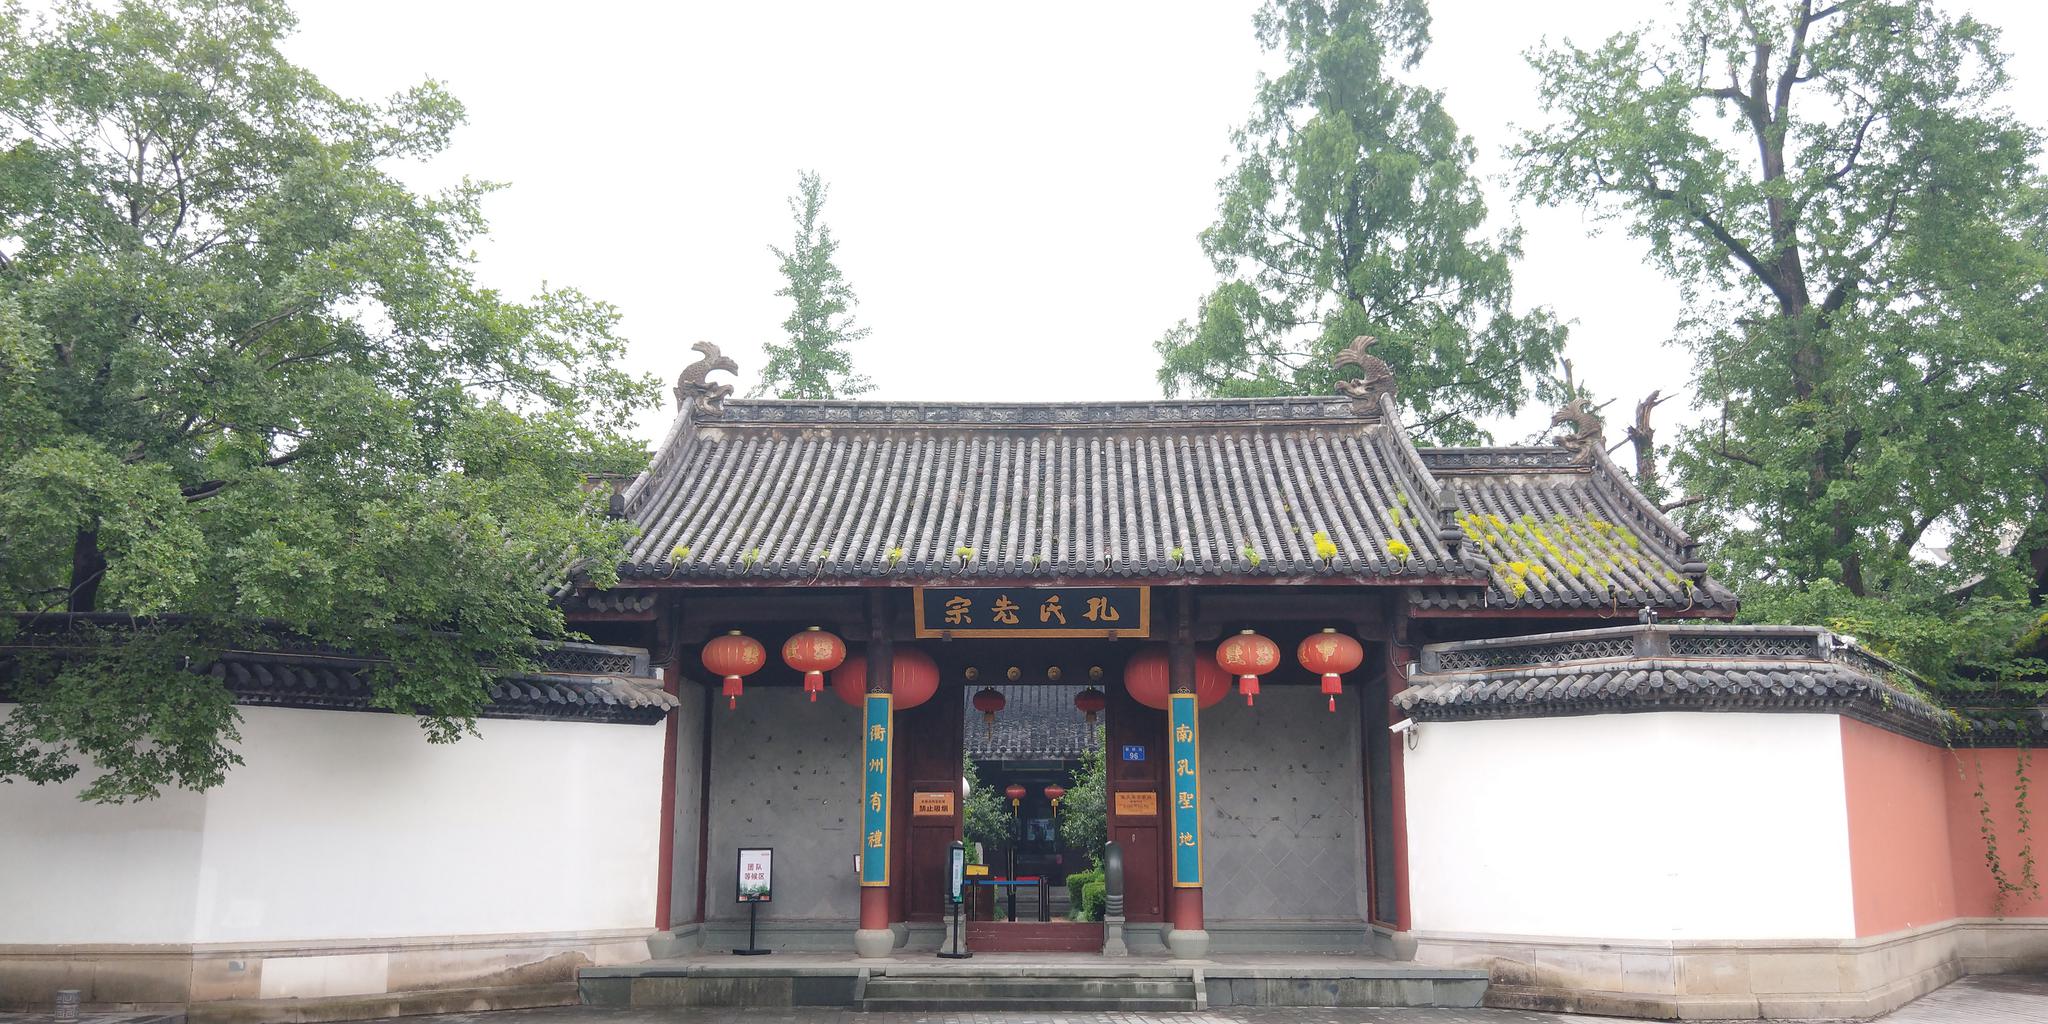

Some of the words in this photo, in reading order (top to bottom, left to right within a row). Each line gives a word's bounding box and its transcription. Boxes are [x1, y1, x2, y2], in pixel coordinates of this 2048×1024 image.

[867, 724, 887, 849] 衢州有禮
[1175, 723, 1196, 847] 南孔聖地
